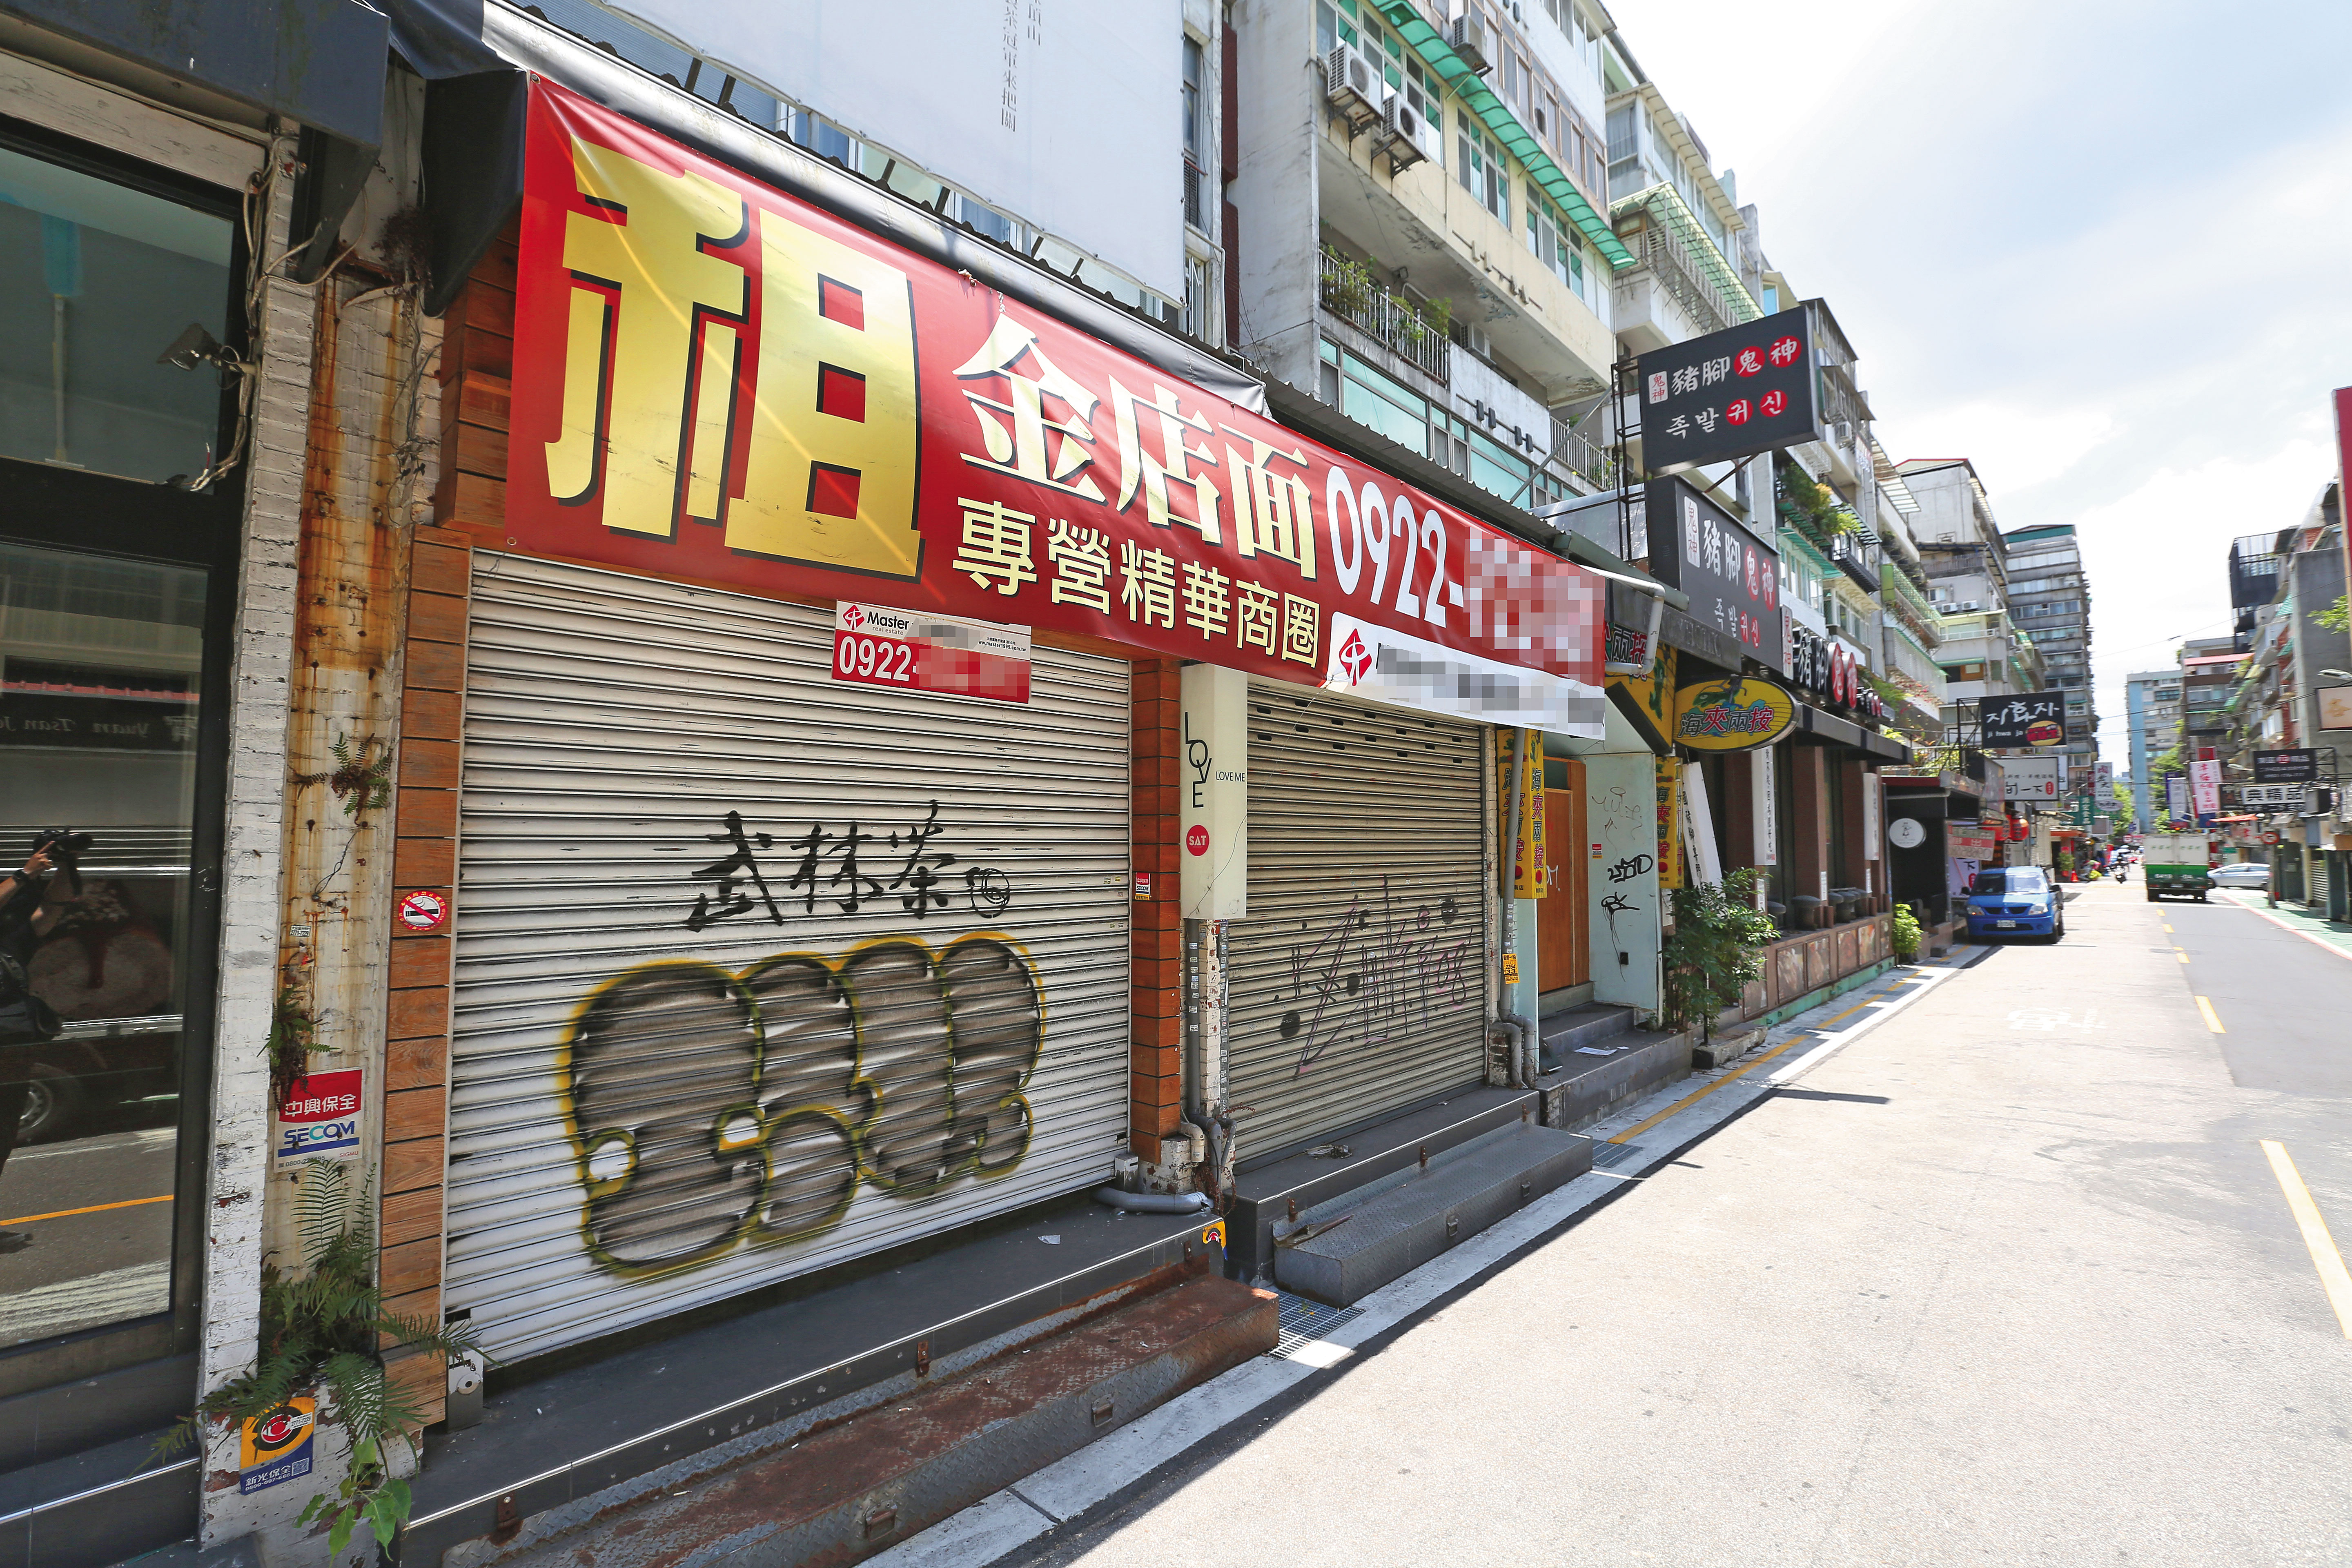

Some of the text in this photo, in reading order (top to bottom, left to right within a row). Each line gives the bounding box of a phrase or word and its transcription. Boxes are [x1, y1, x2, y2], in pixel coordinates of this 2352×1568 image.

[1027, 0, 1041, 46] 頂山
[545, 133, 925, 584] 租
[1671, 338, 1797, 396] 豬腳鬼神
[952, 312, 1316, 580] 金店面
[952, 496, 1321, 669] 專營精華商圈
[867, 610, 910, 630] Master
[978, 641, 1027, 652] ww.master1995.com.tw
[1677, 705, 1775, 738] 海夾兩按
[1185, 711, 1212, 808] LOVE
[1216, 771, 1245, 782] LOVE ME
[1531, 768, 1544, 869] 海夾兩按
[1189, 835, 1207, 846] SAT
[285, 1094, 356, 1117] 中興保全
[284, 1121, 355, 1145] SECOM
[286, 1156, 326, 1167] 0800-2295
[245, 1465, 291, 1486] 新光保全
